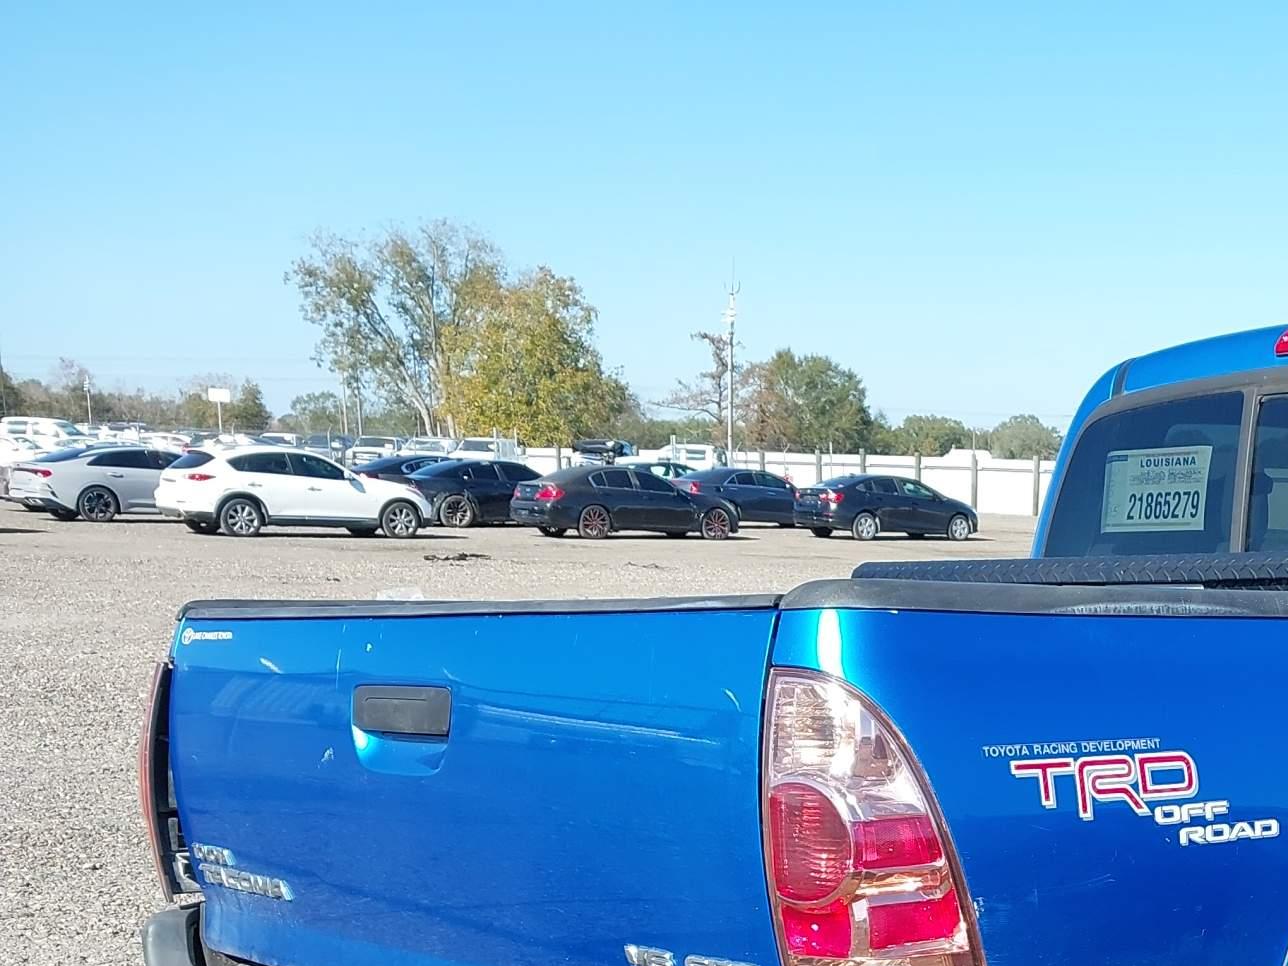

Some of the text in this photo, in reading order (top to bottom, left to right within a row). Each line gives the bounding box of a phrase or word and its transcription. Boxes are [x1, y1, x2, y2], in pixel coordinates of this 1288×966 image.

[1140, 456, 1197, 468] LOUISIANA
[1126, 490, 1200, 520] 21865279
[983, 738, 1161, 757] TOYOTA RACING DEVELOPMENT
[1009, 751, 1199, 820] TRD
[1154, 800, 1230, 824] OFF
[1179, 818, 1280, 846] ROAD
